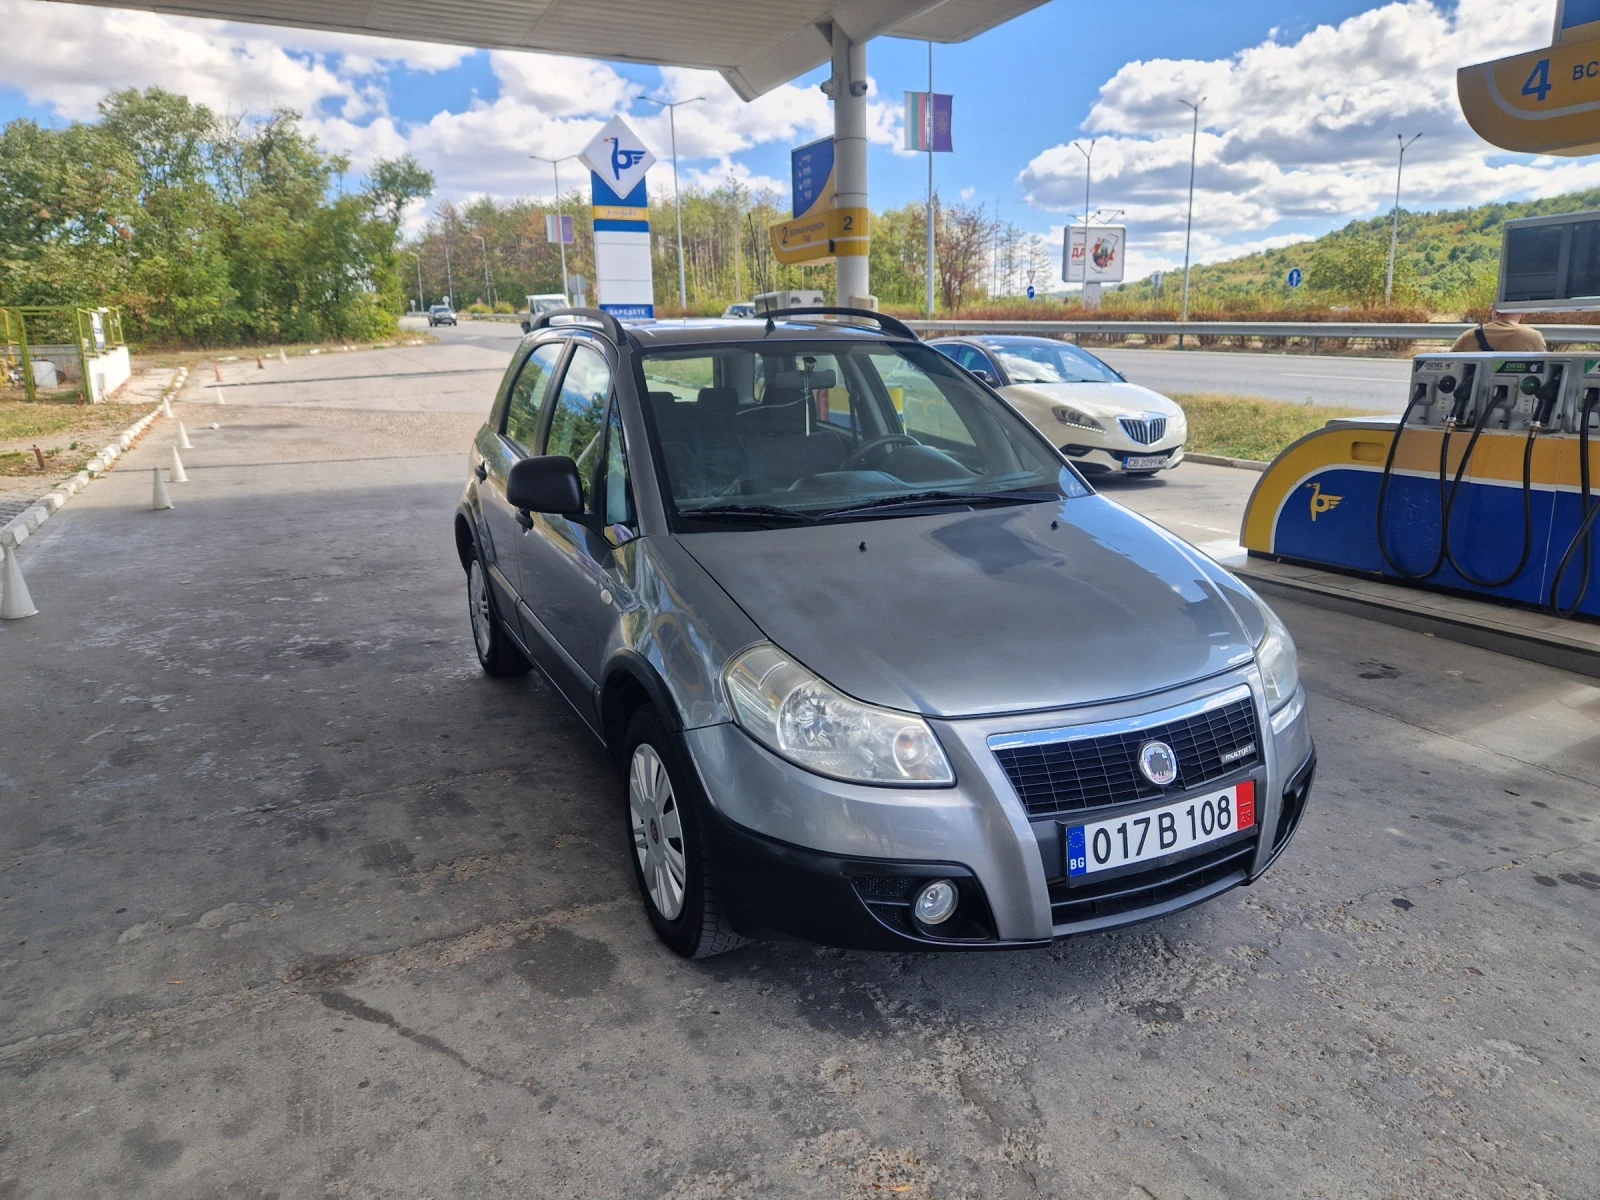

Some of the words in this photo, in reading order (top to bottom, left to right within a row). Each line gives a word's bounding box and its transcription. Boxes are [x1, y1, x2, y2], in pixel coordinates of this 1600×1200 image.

[1521, 58, 1552, 102] 4
[843, 216, 853, 231] 2
[781, 226, 789, 245] 2
[1070, 857, 1085, 871] BG
